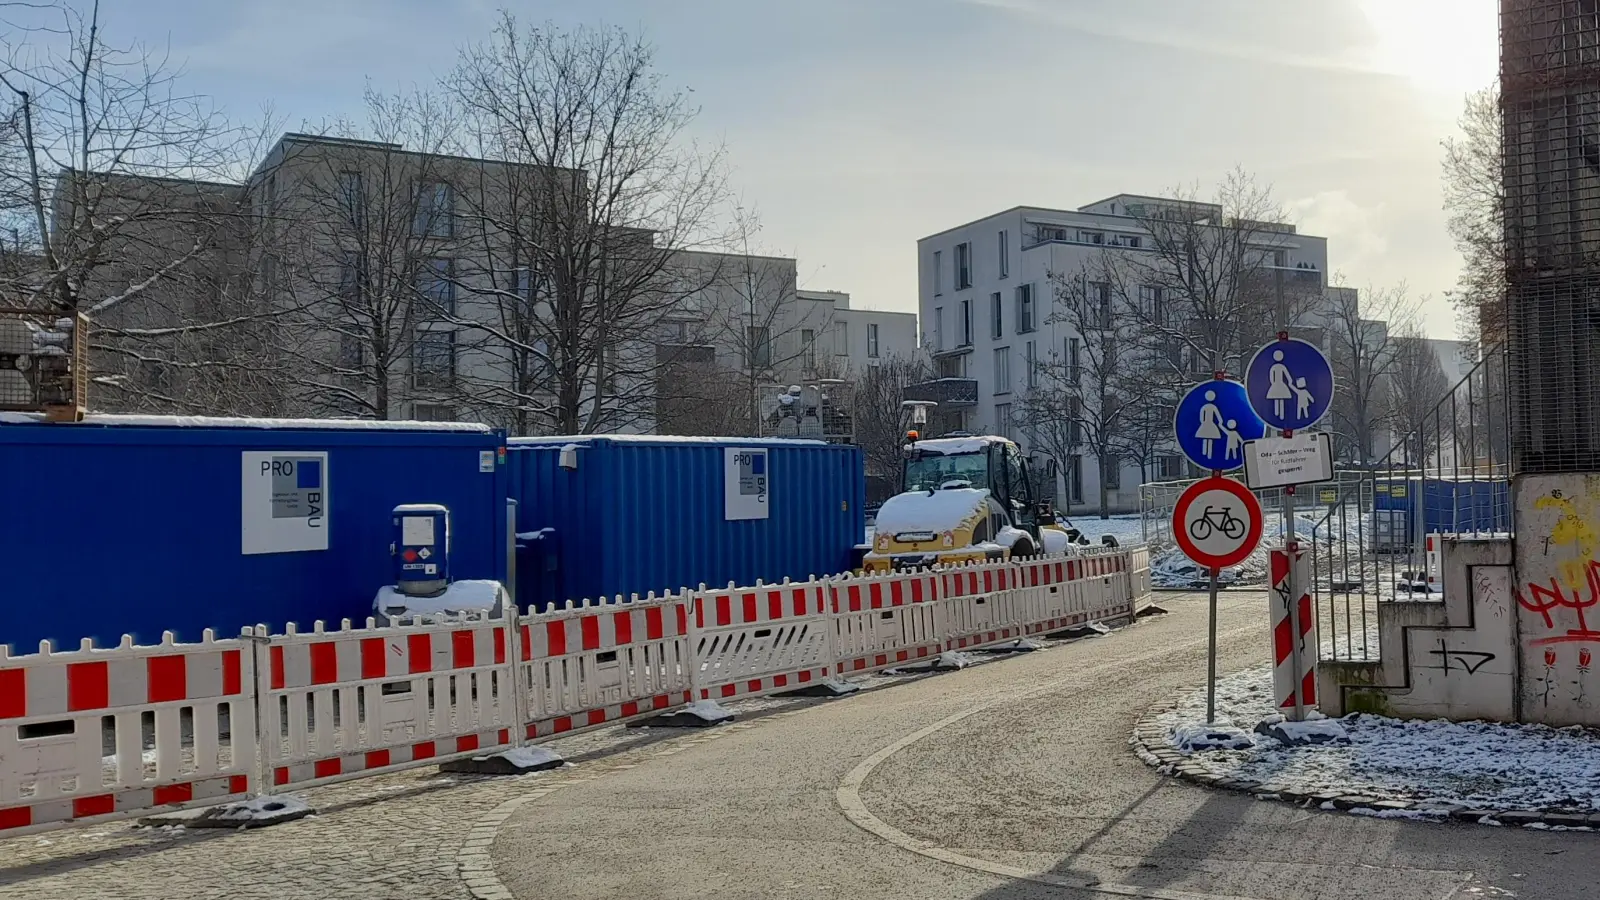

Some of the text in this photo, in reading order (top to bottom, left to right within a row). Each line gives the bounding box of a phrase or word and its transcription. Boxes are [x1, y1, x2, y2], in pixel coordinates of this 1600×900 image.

[261, 460, 293, 476] PRO
[734, 454, 751, 466] PRO
[757, 477, 765, 503] BAU
[307, 492, 321, 528] BAU
